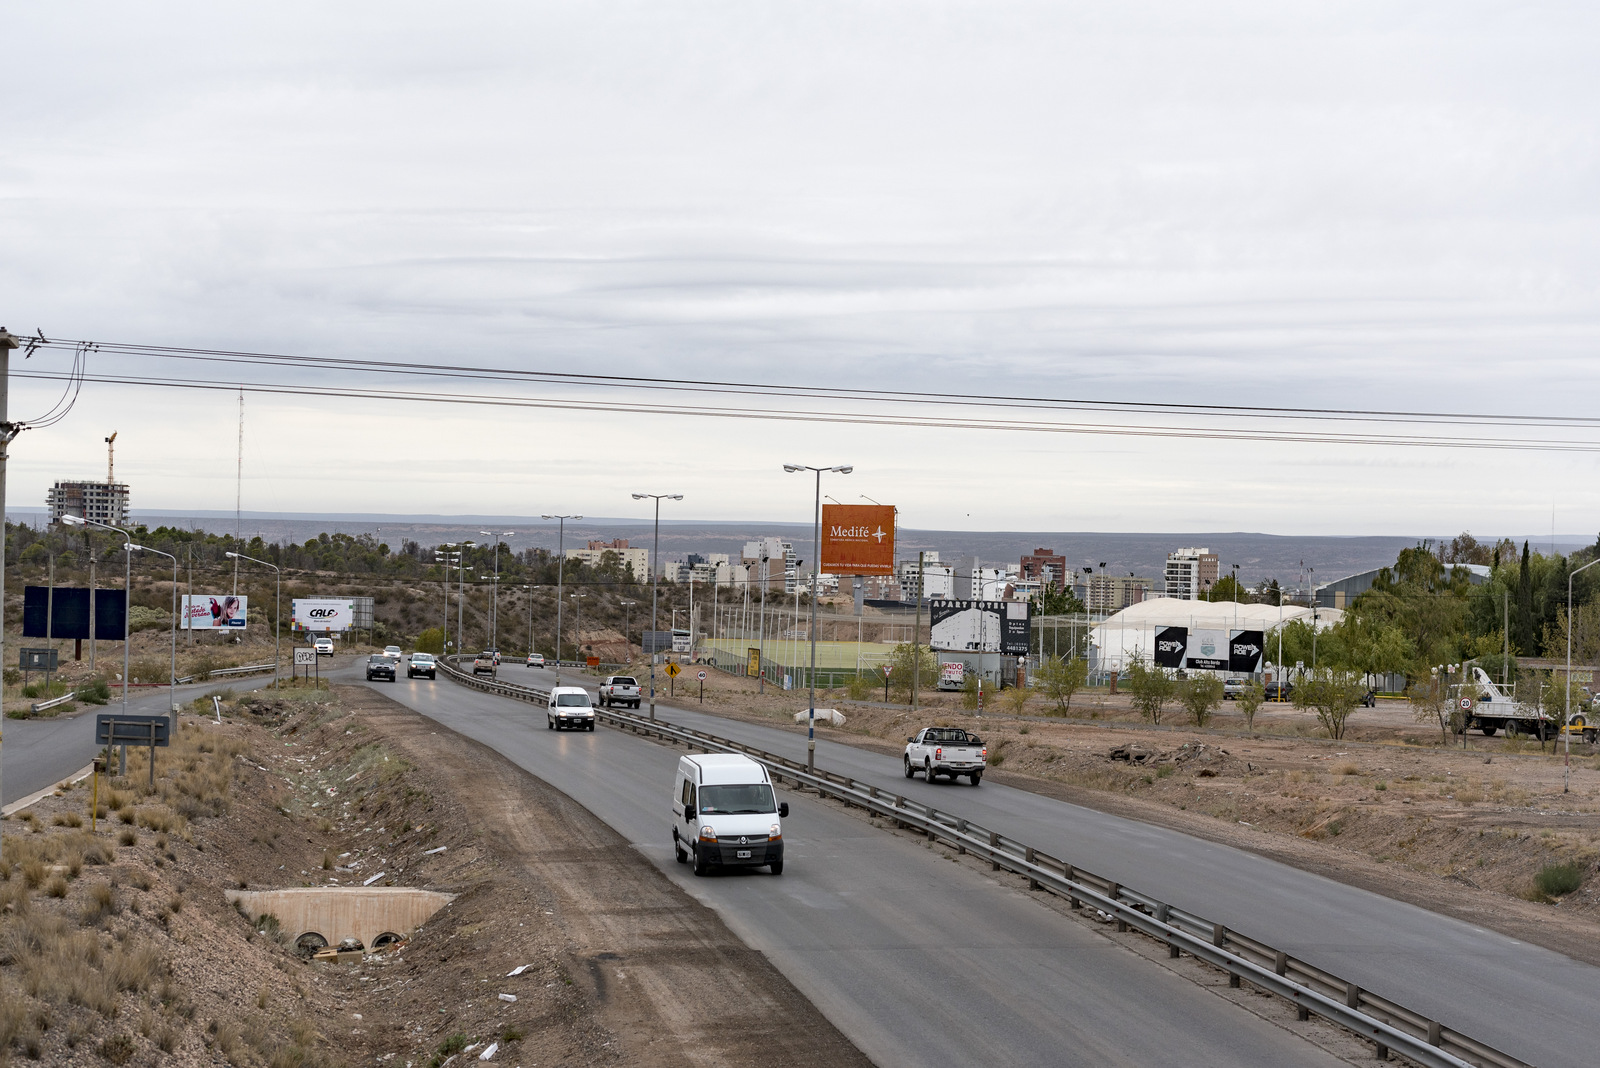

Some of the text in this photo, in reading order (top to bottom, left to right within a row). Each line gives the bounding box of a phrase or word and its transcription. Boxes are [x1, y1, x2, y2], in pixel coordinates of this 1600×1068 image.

[830, 525, 869, 537] Medifé
[970, 601, 1005, 609] HOTEL
[310, 609, 335, 617] CALF
